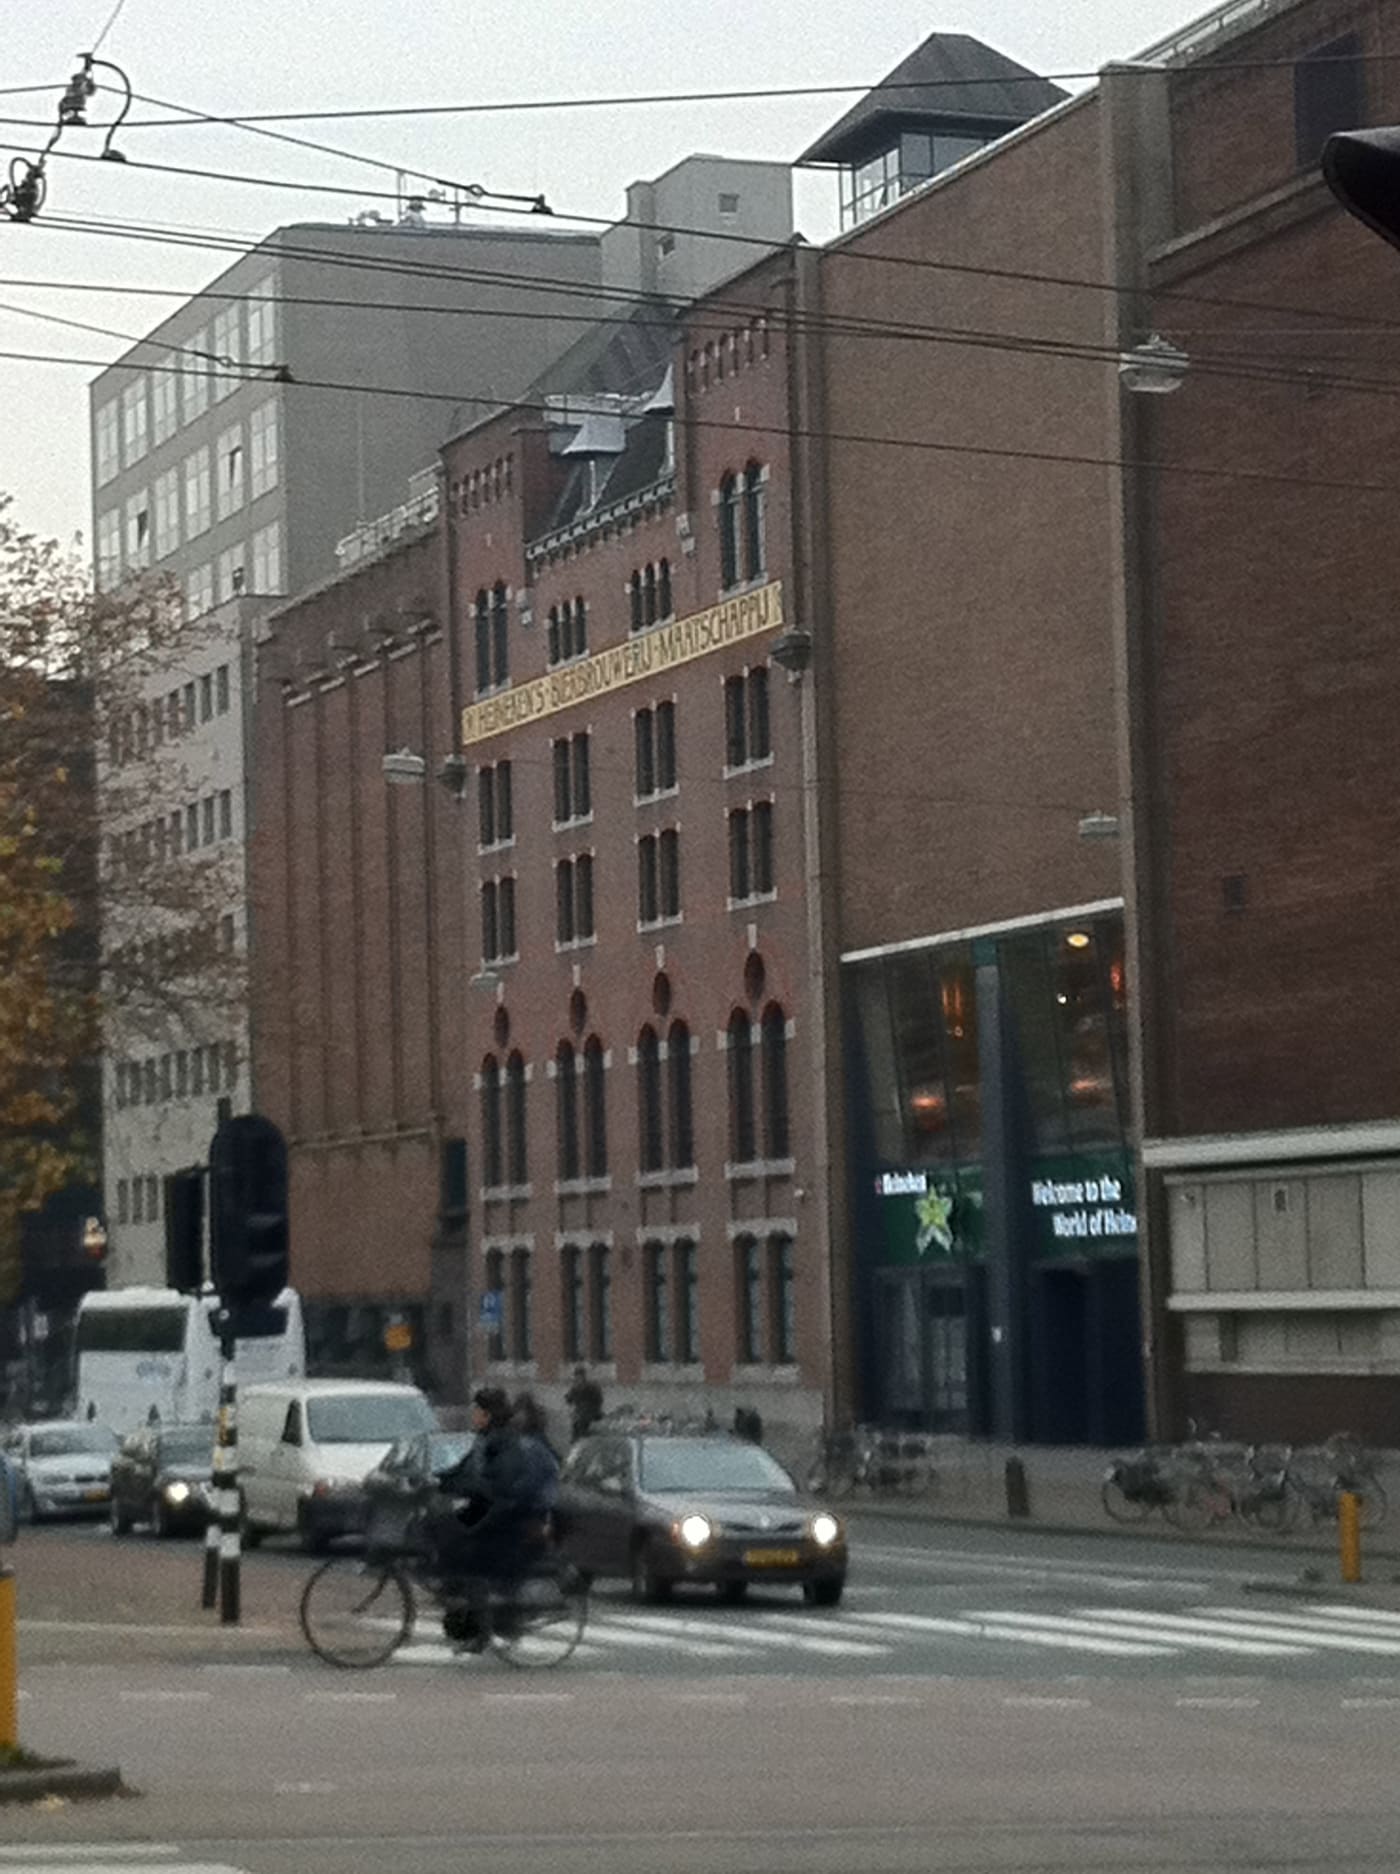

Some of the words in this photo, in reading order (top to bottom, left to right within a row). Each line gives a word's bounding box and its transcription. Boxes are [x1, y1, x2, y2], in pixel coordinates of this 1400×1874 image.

[1032, 1179, 1083, 1205] Welcome
[1085, 1180, 1099, 1202] to
[1100, 1174, 1121, 1201] the
[1053, 1210, 1087, 1236] World
[1089, 1209, 1102, 1235] of
